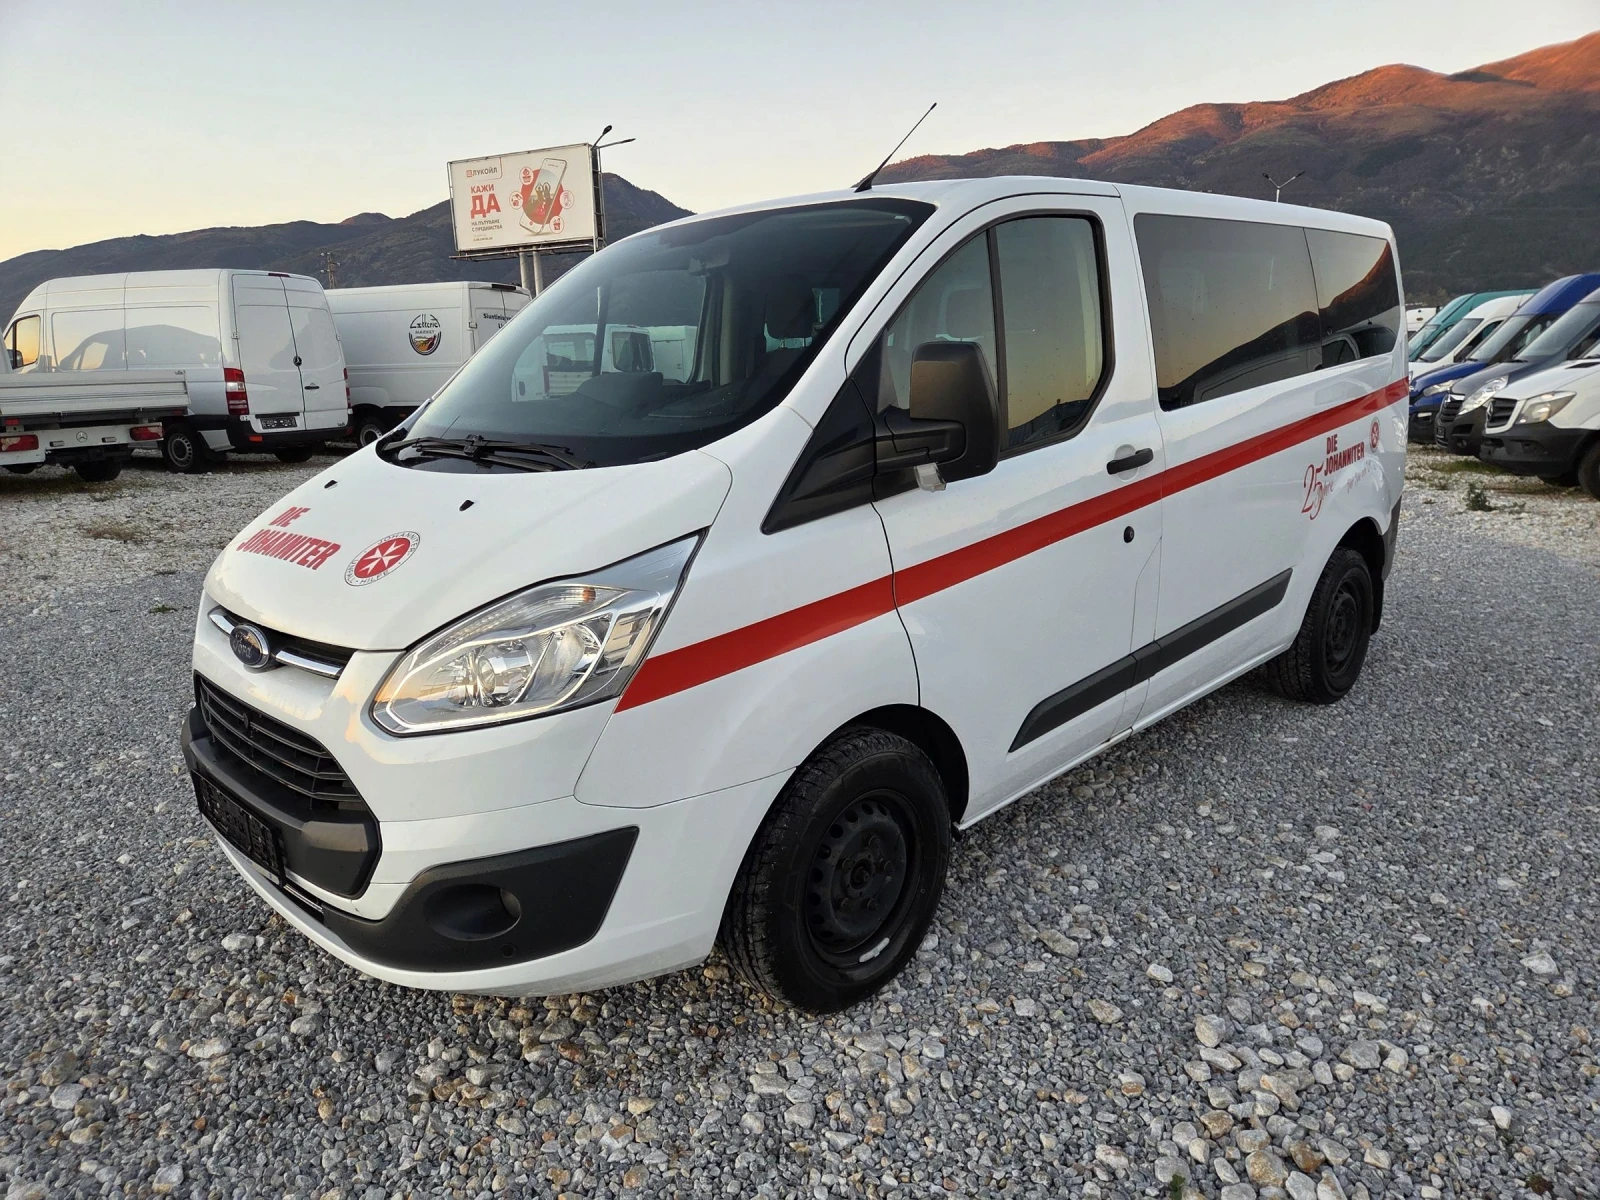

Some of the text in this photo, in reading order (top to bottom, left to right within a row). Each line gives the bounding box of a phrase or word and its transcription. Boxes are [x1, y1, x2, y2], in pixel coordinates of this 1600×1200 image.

[472, 167, 498, 176] ЛУКОЙЛ
[470, 184, 494, 193] КАЖИ
[470, 193, 501, 219] ДА
[1326, 433, 1338, 454] DIE
[1323, 441, 1365, 476] JOHANNITER
[1301, 461, 1324, 520] 25
[268, 506, 312, 528] DIE
[235, 528, 341, 571] JOHANNITER
